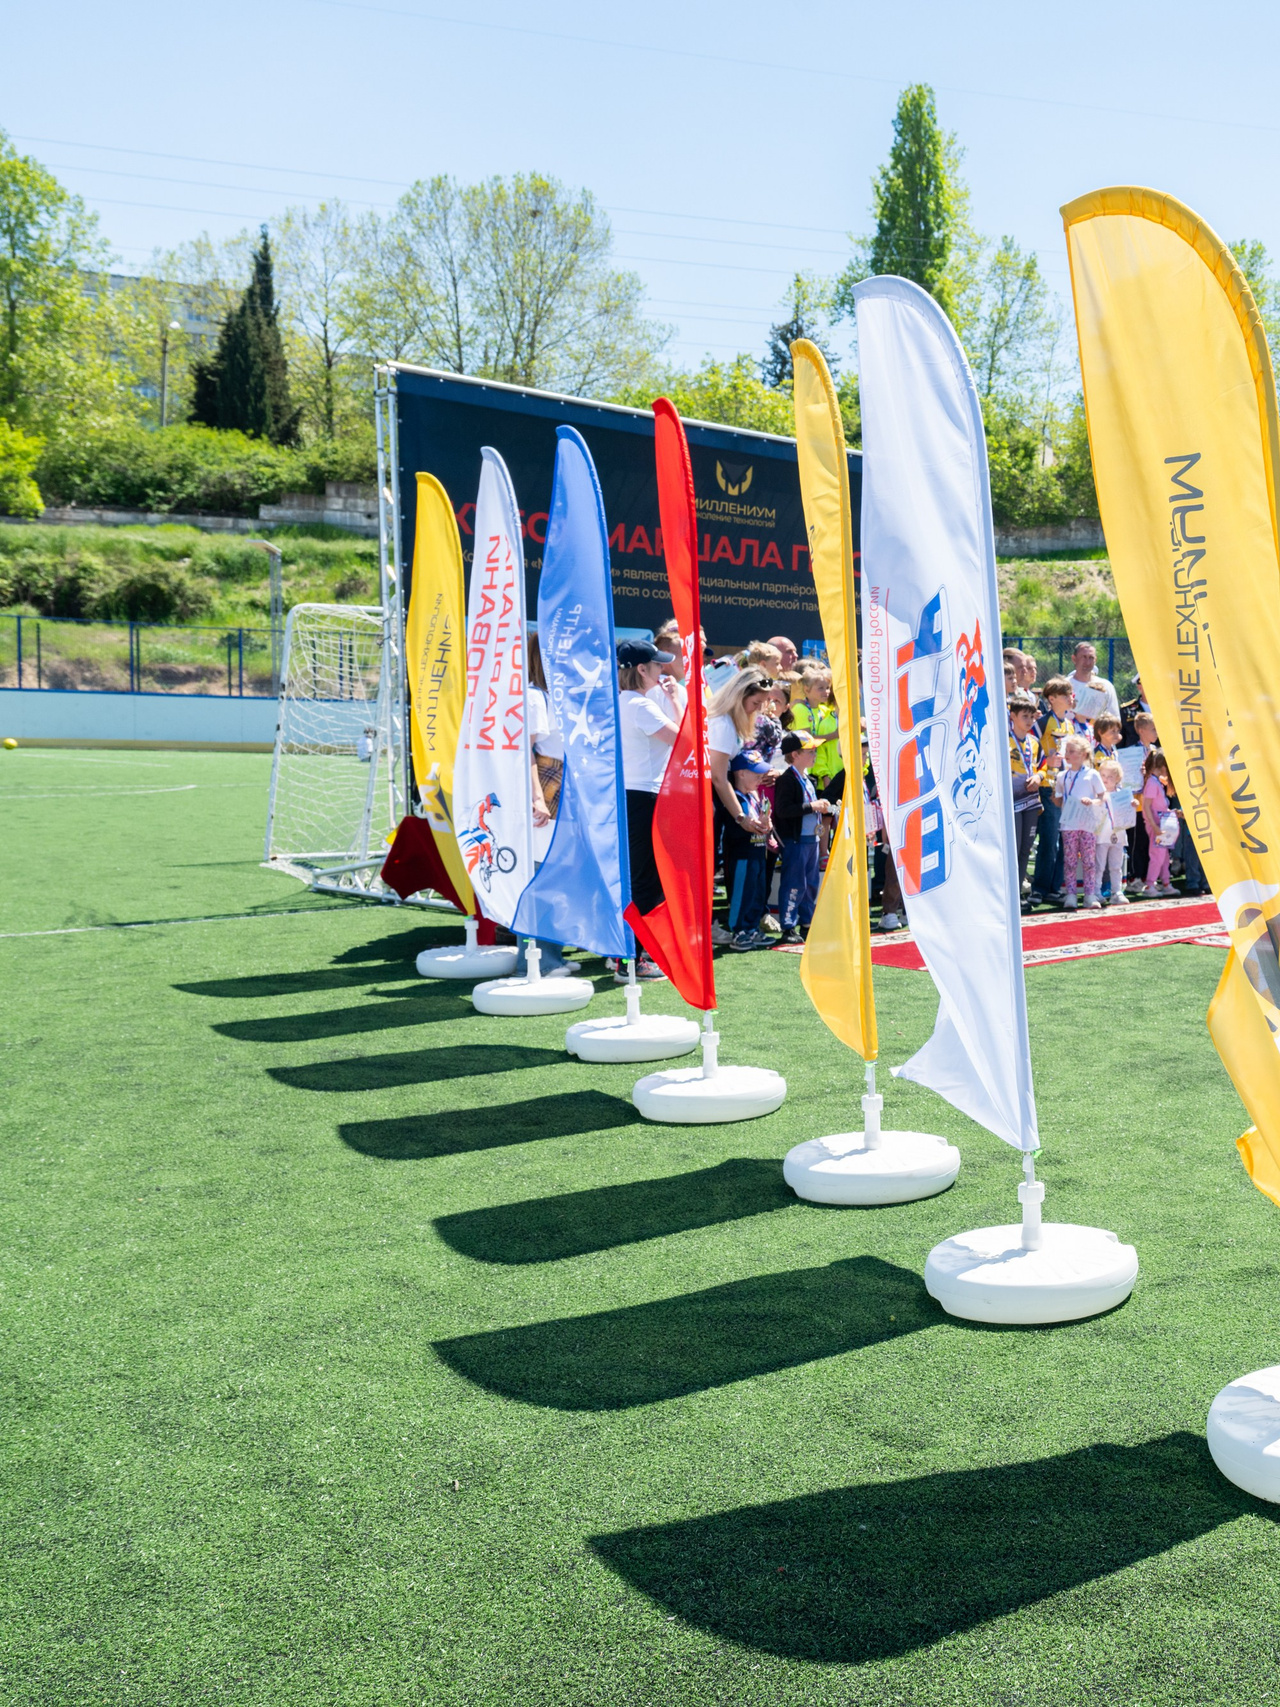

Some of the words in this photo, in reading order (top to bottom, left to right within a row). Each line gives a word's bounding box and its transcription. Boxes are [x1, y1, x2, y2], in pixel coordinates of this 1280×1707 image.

[696, 511, 732, 523] коление
[622, 569, 669, 583] являетс
[724, 597, 800, 610] исторической
